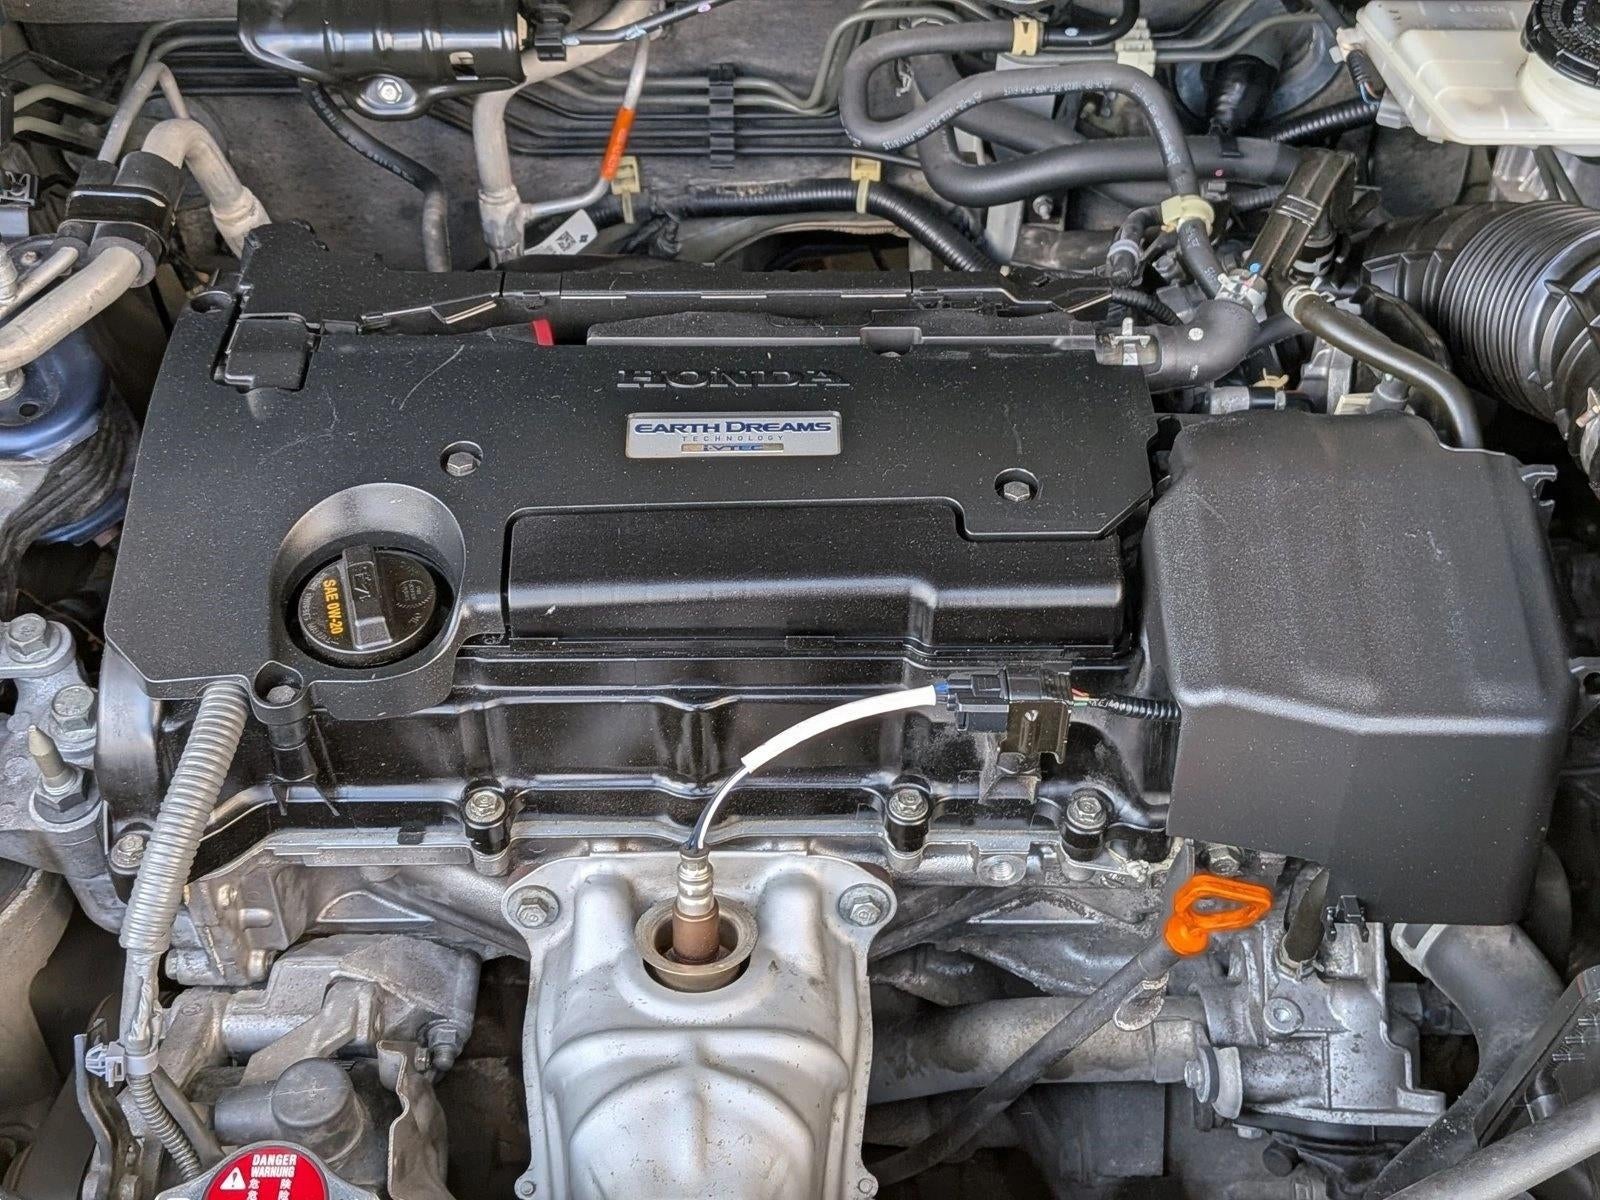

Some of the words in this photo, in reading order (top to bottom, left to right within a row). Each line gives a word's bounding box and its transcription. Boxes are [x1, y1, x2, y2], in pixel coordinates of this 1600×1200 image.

[617, 370, 850, 388] HONDA
[634, 423, 720, 433] EARTH
[725, 421, 831, 433] DREAMS
[322, 579, 338, 602] SAE
[326, 602, 344, 635] 0W-20
[252, 1154, 297, 1166] DANGER
[251, 1166, 295, 1178] WARNUNG
